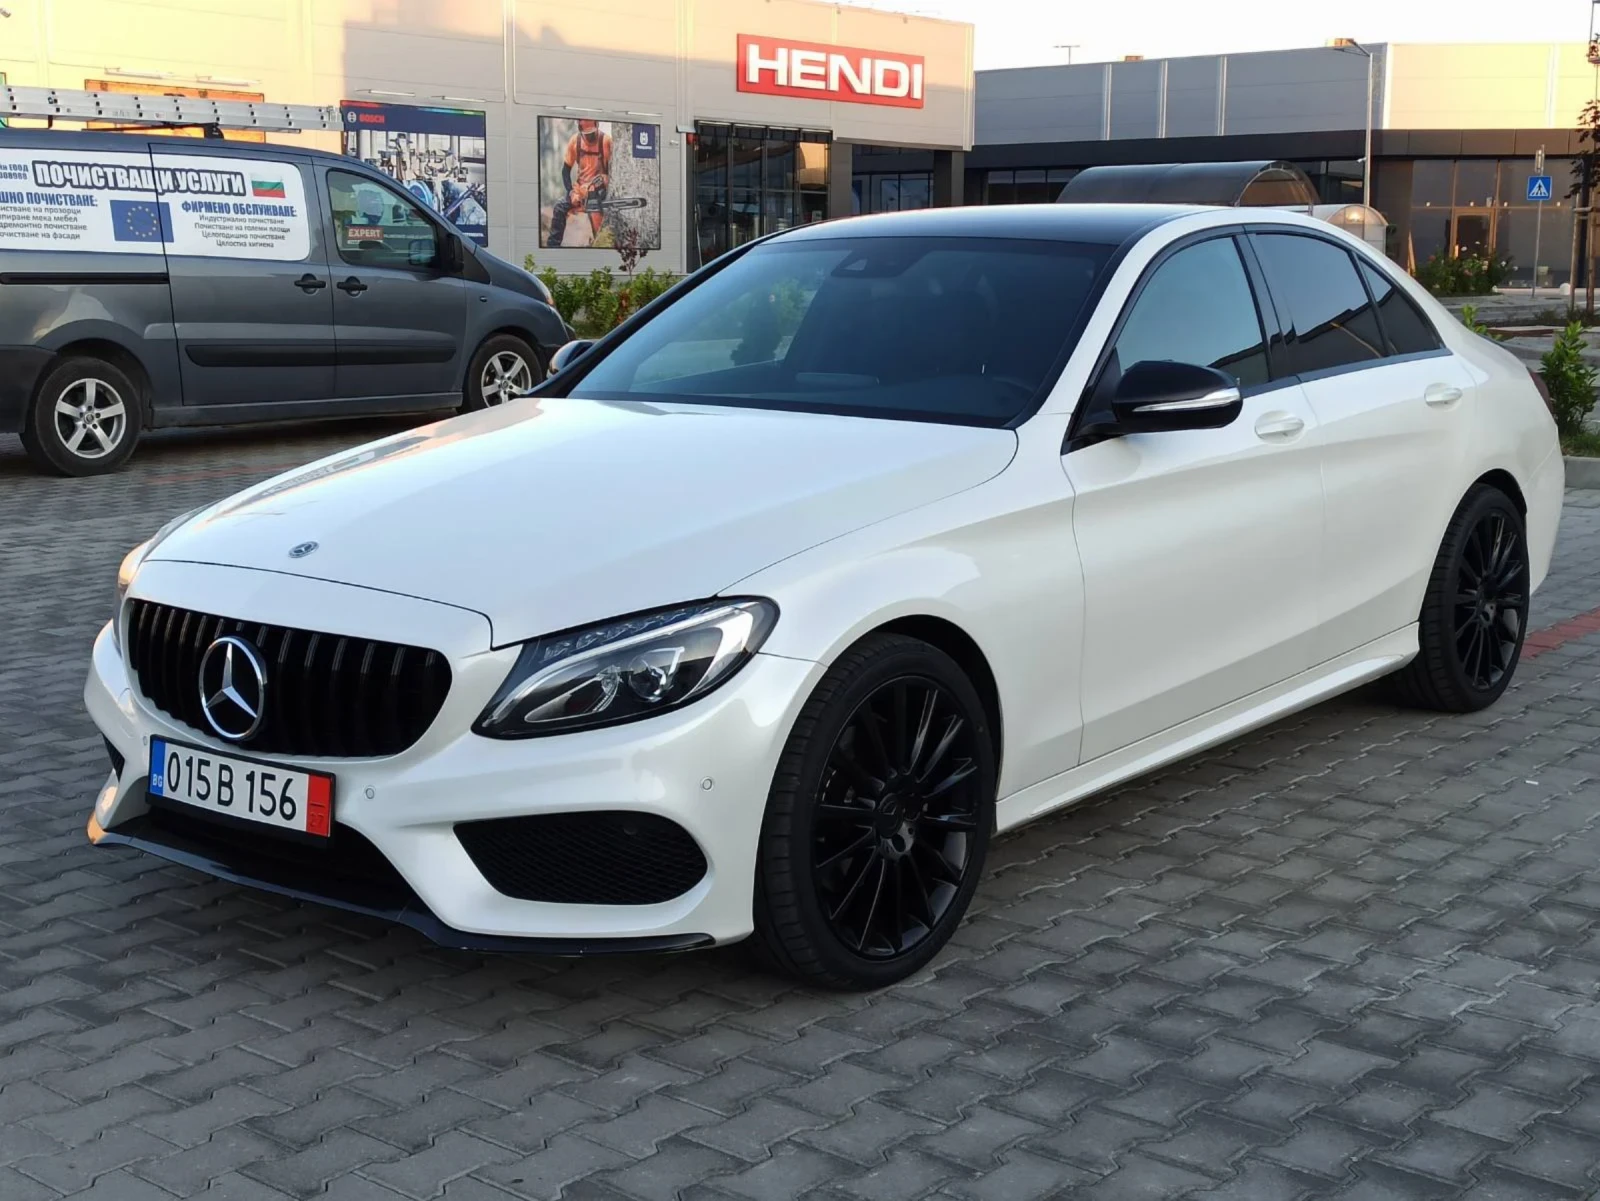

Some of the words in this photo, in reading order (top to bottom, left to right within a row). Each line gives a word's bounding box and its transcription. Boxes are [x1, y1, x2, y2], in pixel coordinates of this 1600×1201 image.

[745, 43, 923, 99] HENDI
[33, 161, 175, 195] ПОЧИСТВАЩИ
[176, 168, 246, 195] УСЛУГИ
[26, 192, 98, 207] ПОЧИСТВАНЕ:
[45, 207, 81, 215] прозорци
[181, 200, 231, 213] ФИРМЕНО
[234, 203, 298, 217] ОБСЛУЖВАНЕ:
[199, 215, 247, 223] Индустриално
[248, 217, 285, 225] почистване
[194, 223, 234, 231] Почистване
[348, 228, 381, 238] EXPERT
[52, 232, 81, 240] фасади
[152, 773, 163, 788] BG
